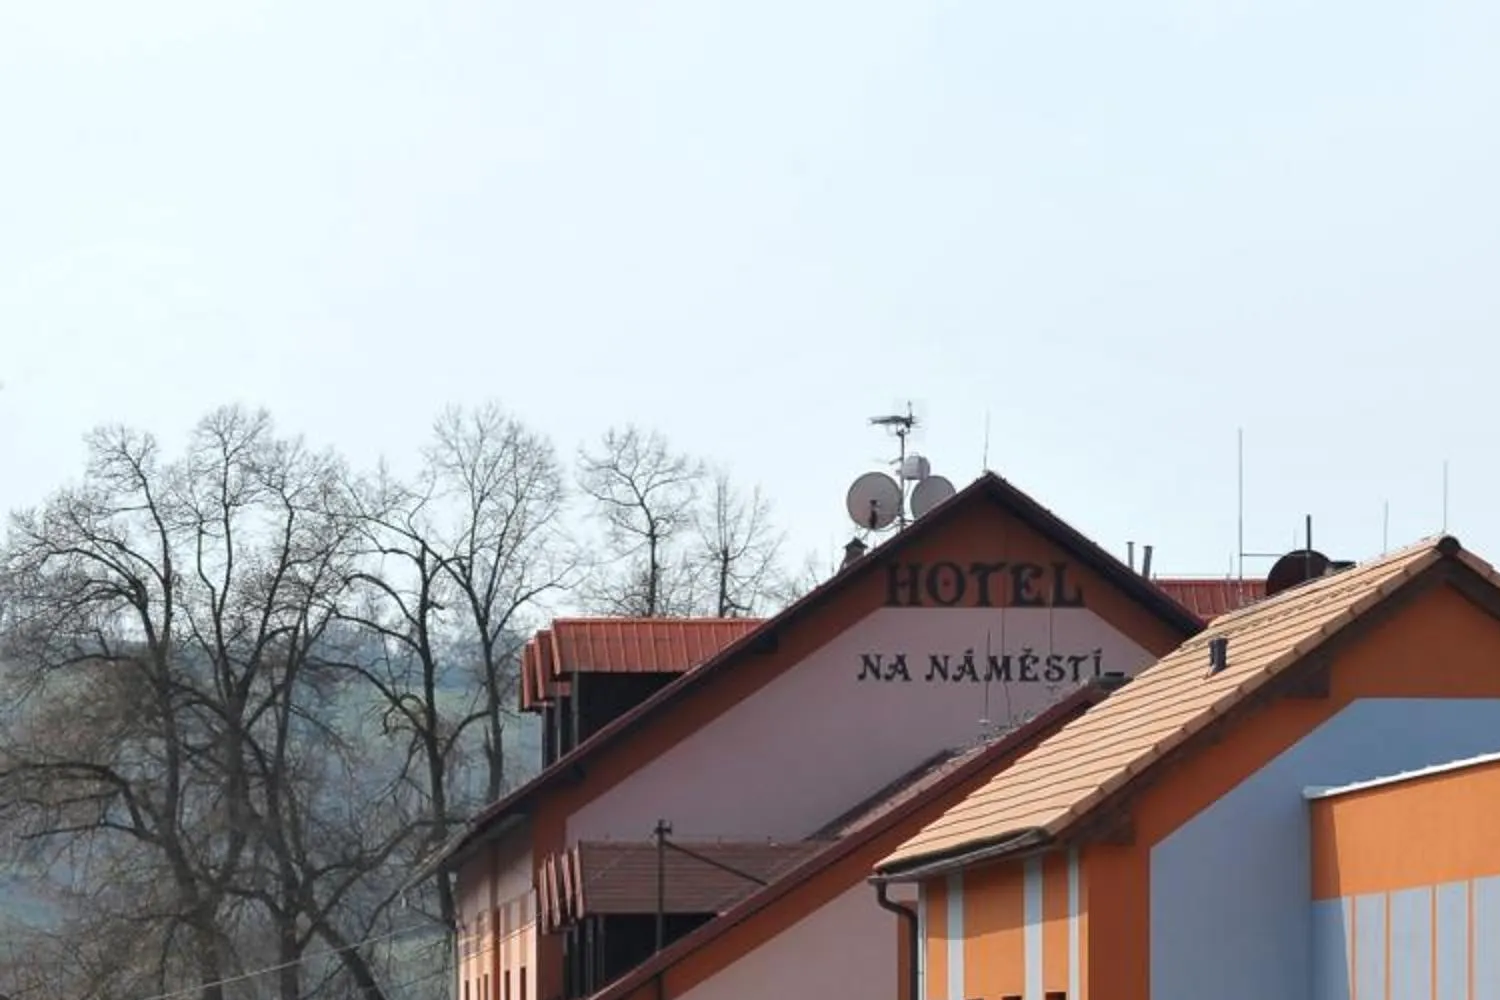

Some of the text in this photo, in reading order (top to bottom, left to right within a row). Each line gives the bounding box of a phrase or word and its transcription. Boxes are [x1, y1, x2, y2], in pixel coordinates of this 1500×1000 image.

[886, 561, 1085, 608] HOTEL
[857, 648, 1103, 682] NA NÁMĚSTÍ
